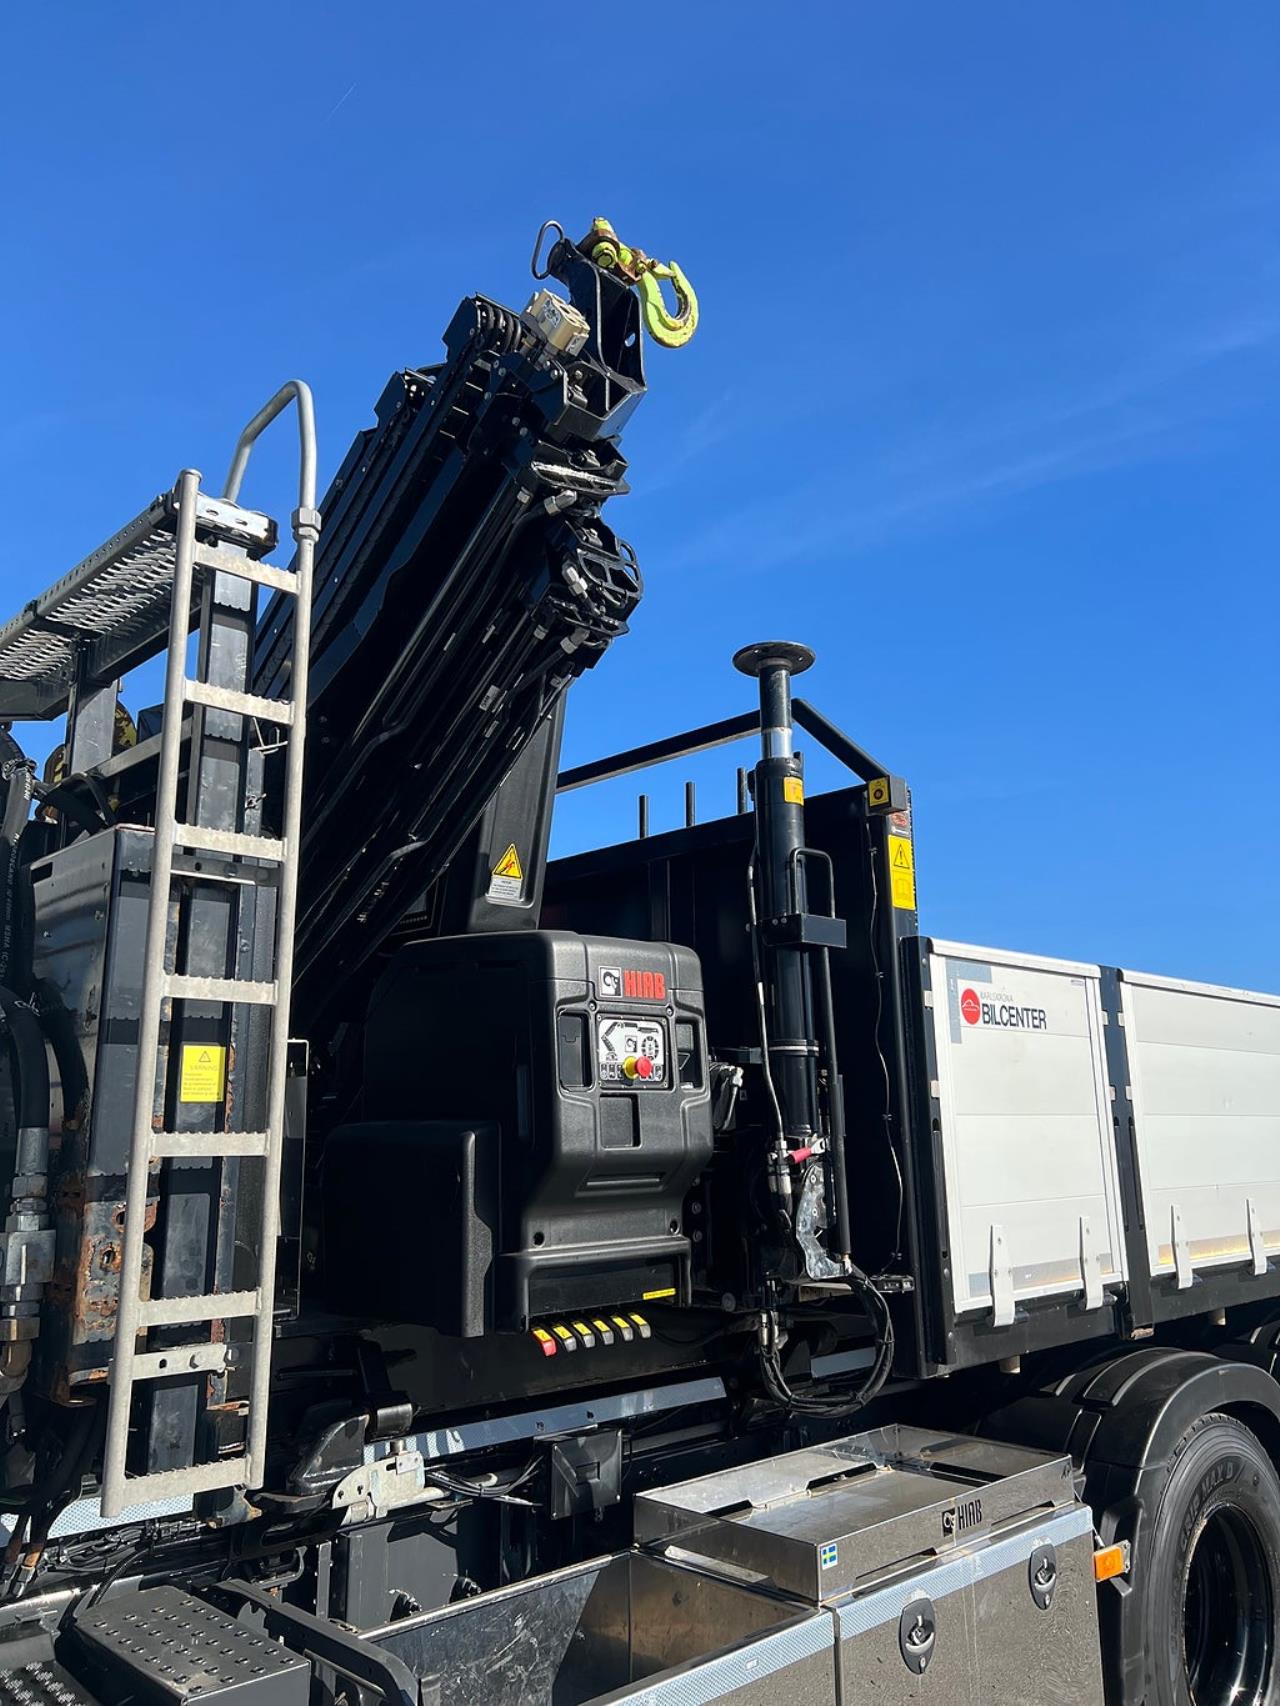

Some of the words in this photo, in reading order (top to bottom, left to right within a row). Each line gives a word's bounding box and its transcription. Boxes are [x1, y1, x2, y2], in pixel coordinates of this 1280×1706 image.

[624, 969, 666, 1000] HIAB
[982, 1003, 1047, 1030] BILCENTER
[957, 1499, 982, 1530] HIAB
